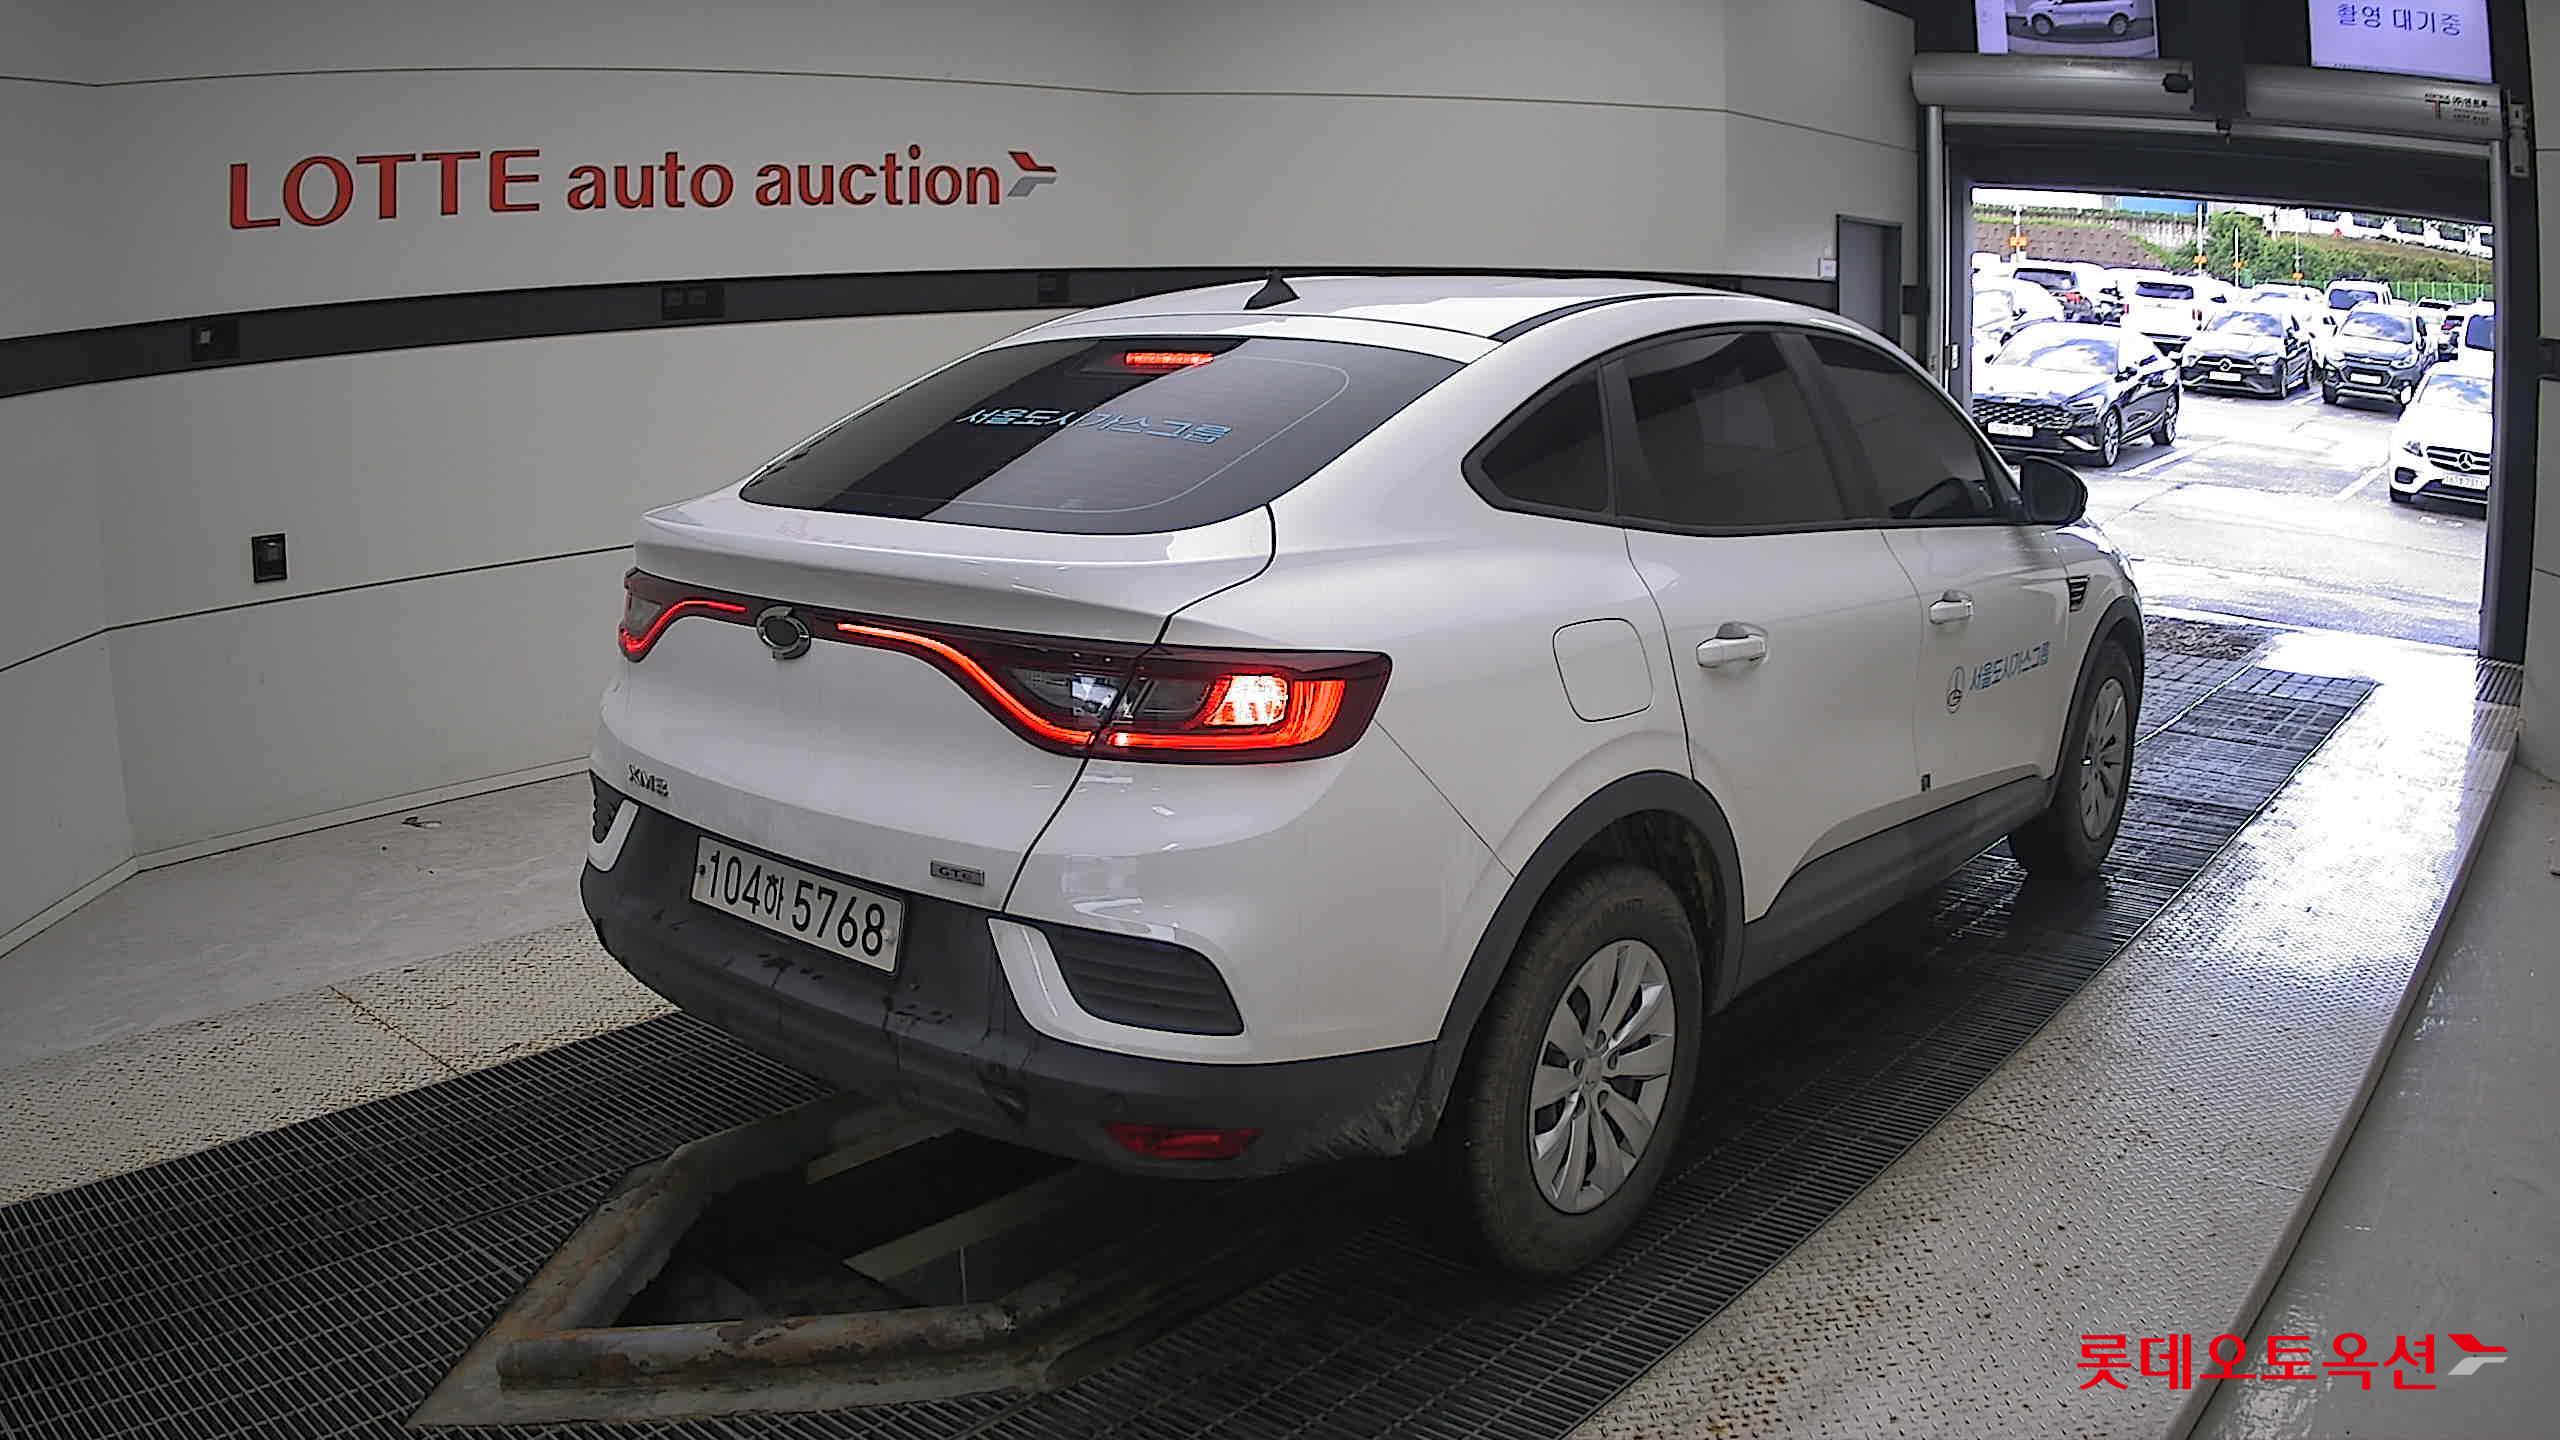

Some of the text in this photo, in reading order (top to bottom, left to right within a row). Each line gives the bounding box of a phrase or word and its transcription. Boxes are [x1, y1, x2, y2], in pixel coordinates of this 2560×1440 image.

[2338, 4, 2381, 28] 촬영
[230, 145, 1000, 229] LOTTE auto auction
[955, 408, 1232, 445] 서울도시가스그룹
[1969, 641, 2049, 690] 서울도시가스그룹
[710, 850, 885, 957] 104하 5768
